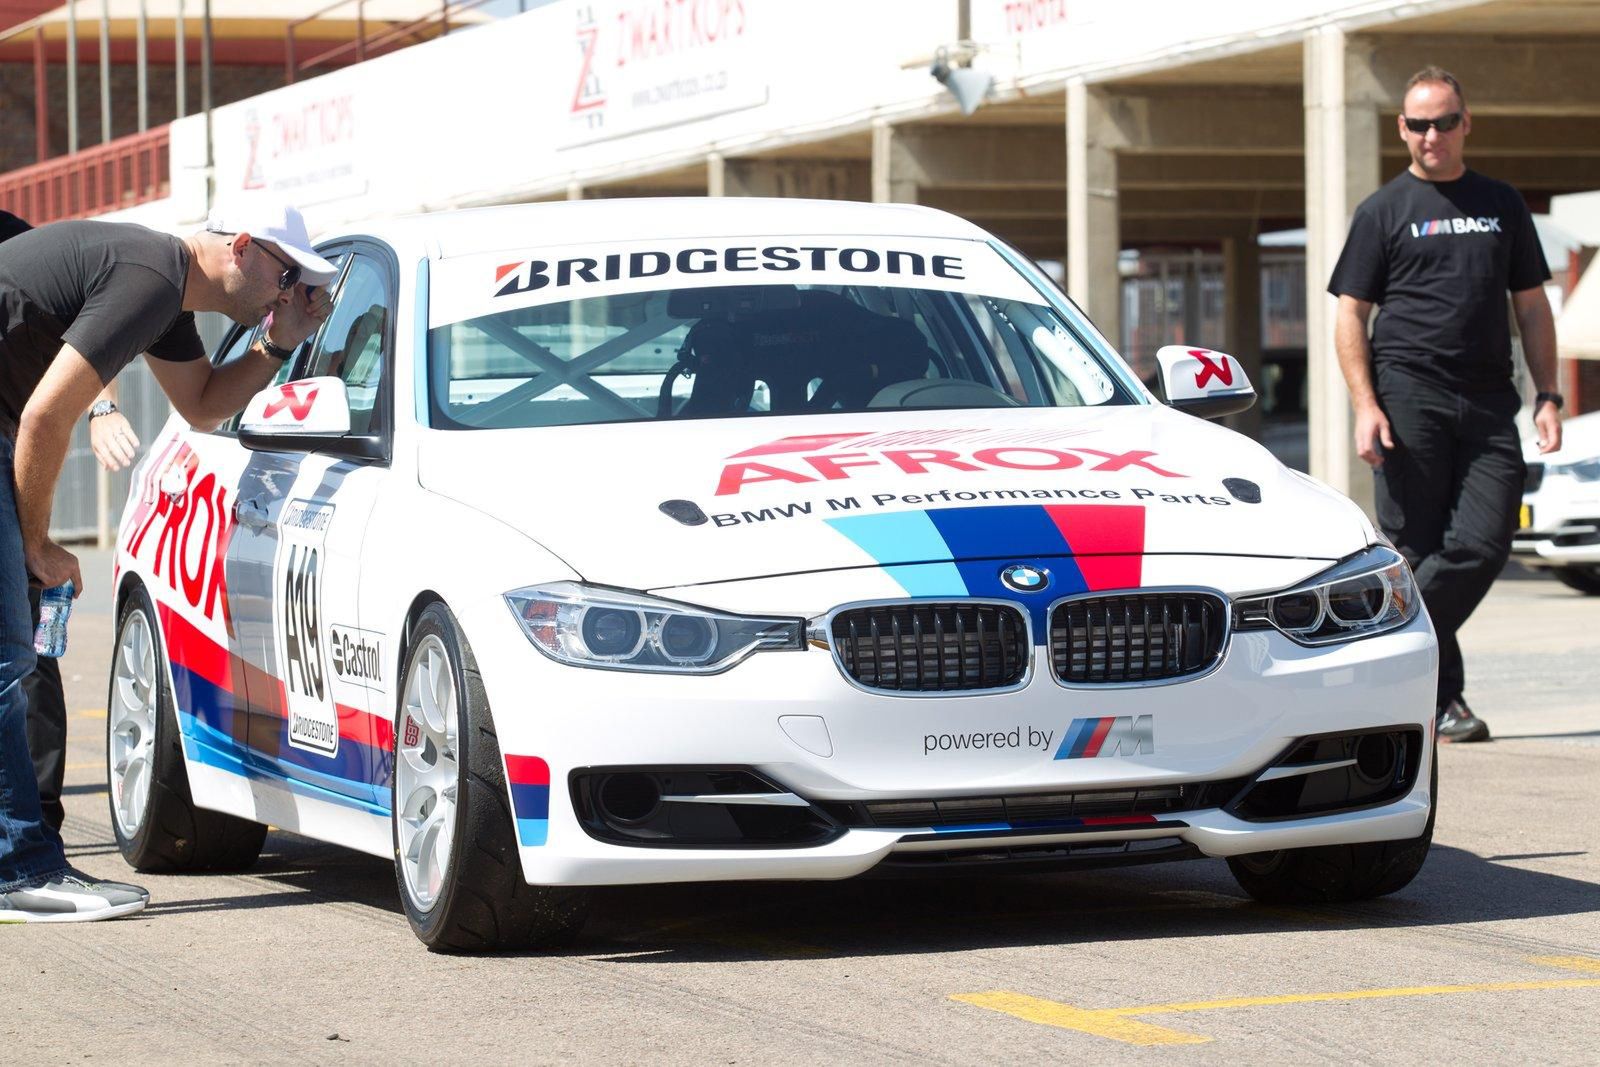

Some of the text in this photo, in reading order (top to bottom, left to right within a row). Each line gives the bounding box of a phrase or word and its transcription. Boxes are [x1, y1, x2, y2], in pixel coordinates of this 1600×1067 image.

[1452, 217, 1502, 234] BACK
[493, 246, 966, 298] BRIDGESTONE
[714, 447, 1191, 496] AFROX
[711, 487, 1232, 527] BMW M Performance Parts
[285, 544, 325, 702] A19
[343, 634, 382, 682] Castrol
[292, 712, 334, 744] BRIDGESTONE
[924, 726, 1020, 756] powered
[1028, 726, 1054, 751] by
